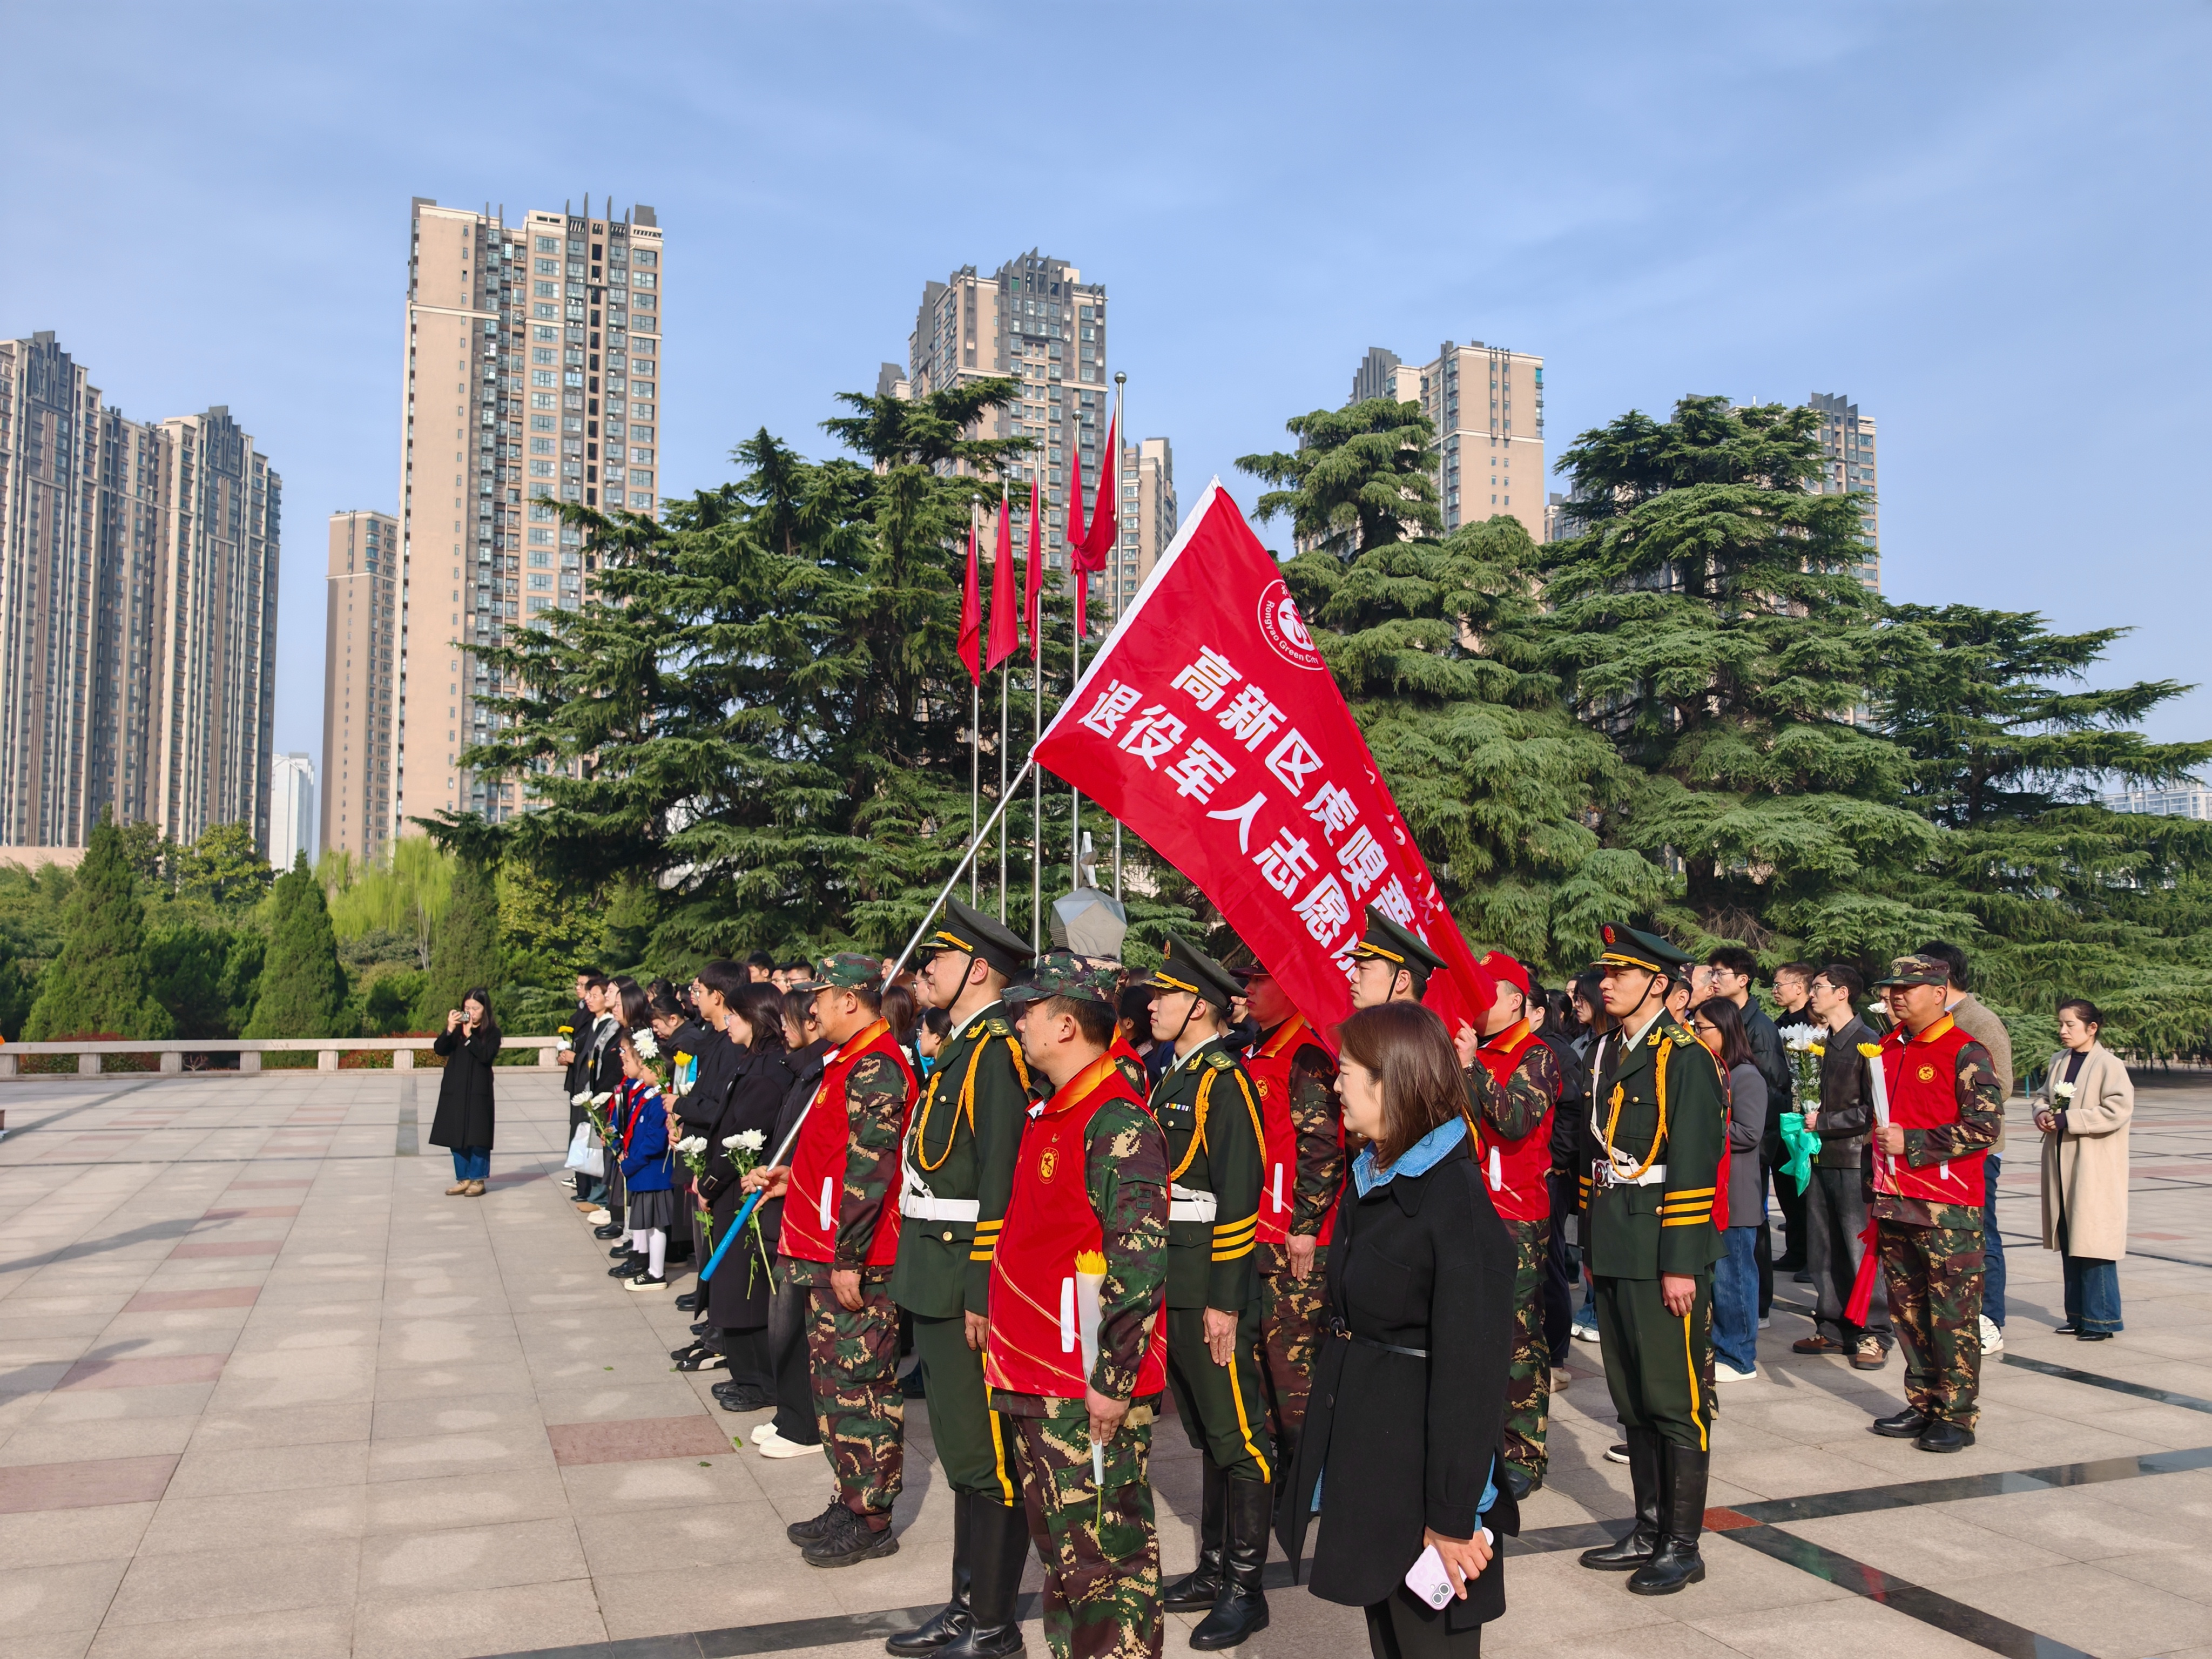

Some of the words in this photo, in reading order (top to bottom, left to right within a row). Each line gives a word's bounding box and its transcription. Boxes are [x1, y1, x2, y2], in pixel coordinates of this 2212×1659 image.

[1264, 600, 1279, 641] Rongyao
[1279, 640, 1304, 661] Green
[1305, 654, 1319, 665] City
[1170, 644, 1432, 949] 高新区虎嗅蔷
